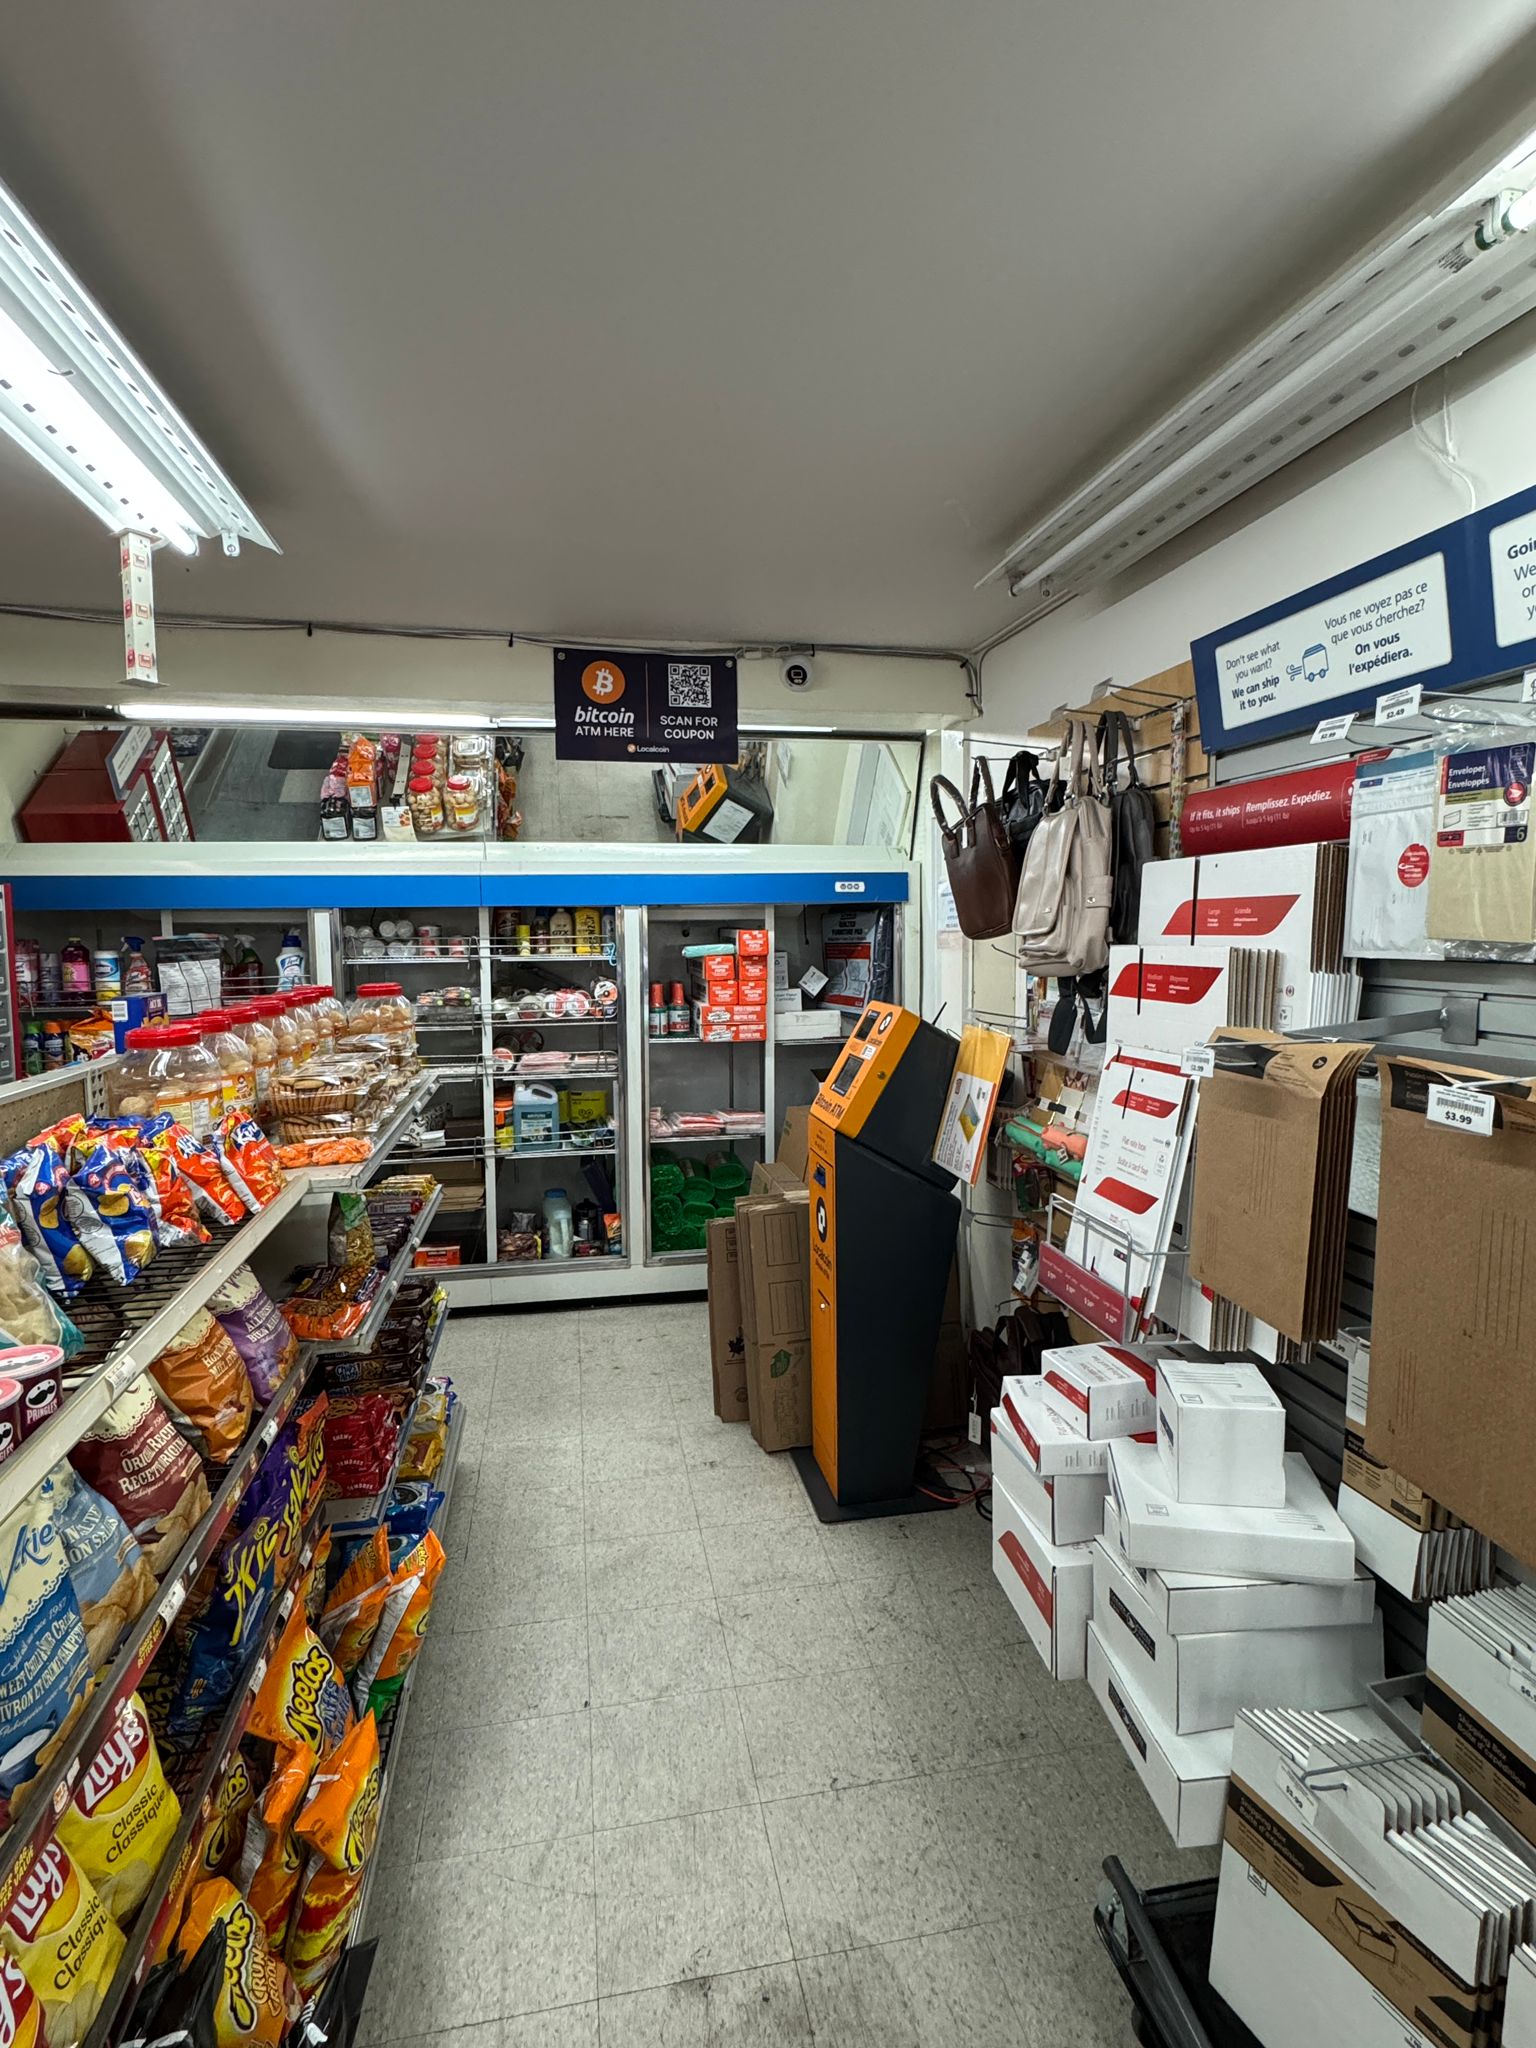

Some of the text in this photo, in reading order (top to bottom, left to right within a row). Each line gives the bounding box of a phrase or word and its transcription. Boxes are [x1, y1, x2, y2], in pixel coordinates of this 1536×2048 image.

[1324, 582, 1428, 630] Vous ne voyez pas ce
[1330, 598, 1425, 646] que vous cherchez?
[1355, 632, 1400, 655] On vous
[1226, 641, 1280, 670] Don't see what
[1349, 647, 1413, 675] l'expédiera.
[1235, 658, 1273, 683] you want?
[1232, 675, 1280, 699] We can ship
[1239, 693, 1276, 711] it to you.
[574, 706, 635, 724] bitcoin
[660, 715, 718, 727] SCAN FOR
[575, 726, 635, 738] ATM HERE
[664, 729, 715, 740] COUPON
[637, 745, 670, 753] Localcoin
[1448, 765, 1486, 777] Envelopes
[1448, 777, 1490, 789] Enveloppes
[1215, 806, 1222, 817] it
[1222, 805, 1241, 819] ships
[1246, 790, 1332, 813] Remplissez. Expédiez.
[1517, 827, 1525, 841] 6
[830, 1102, 845, 1119] ATM
[1445, 1110, 1472, 1125] $3.99
[26, 1398, 57, 1424] PRINGLES
[0, 1669, 27, 1698] WEET
[286, 1646, 330, 1755] Cheetos
[111, 1783, 158, 1839] Classic
[106, 1789, 166, 1864] Classique
[56, 1895, 101, 1962] Classic
[54, 1912, 109, 1991] Classiqu
